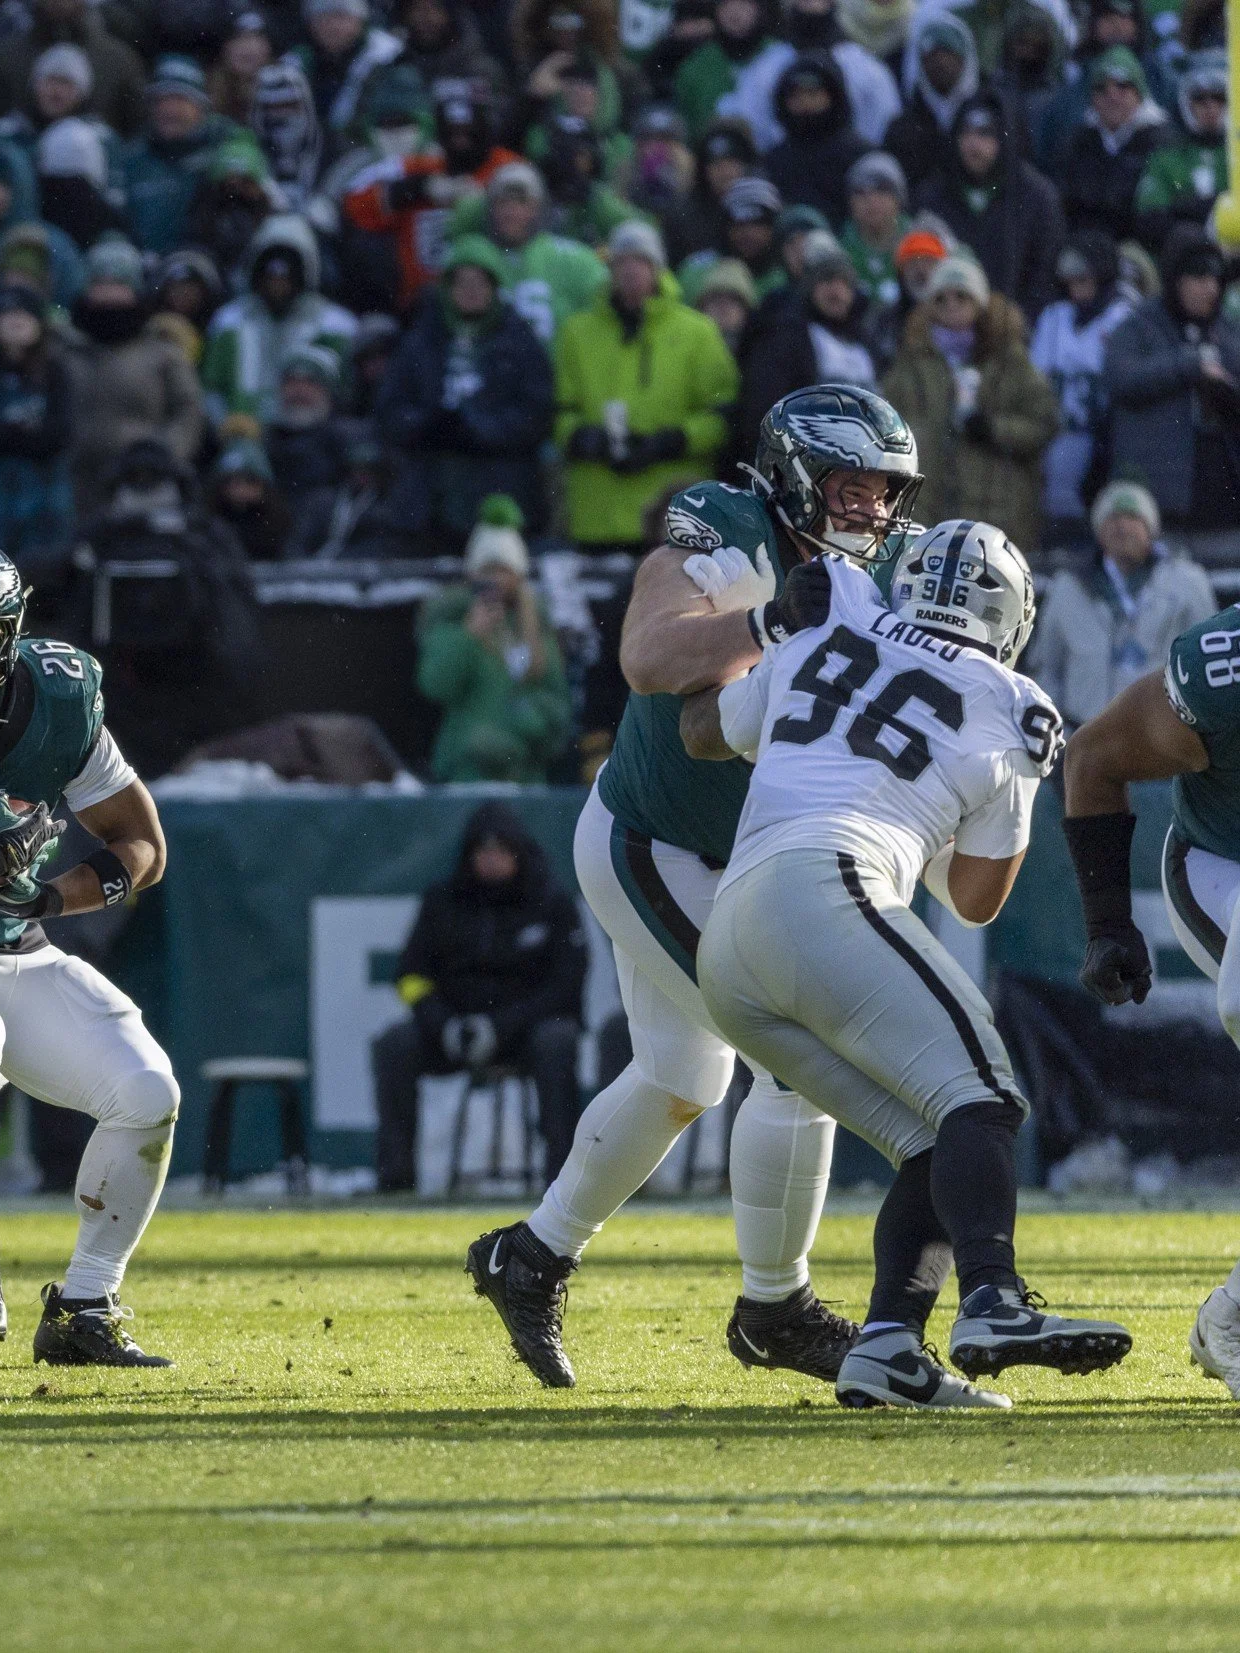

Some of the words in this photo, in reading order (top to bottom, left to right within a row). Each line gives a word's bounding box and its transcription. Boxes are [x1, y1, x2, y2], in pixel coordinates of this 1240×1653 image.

[915, 609, 968, 629] RAIDERS
[31, 641, 86, 680] 26
[769, 625, 966, 783] 96
[102, 878, 125, 906] 26
